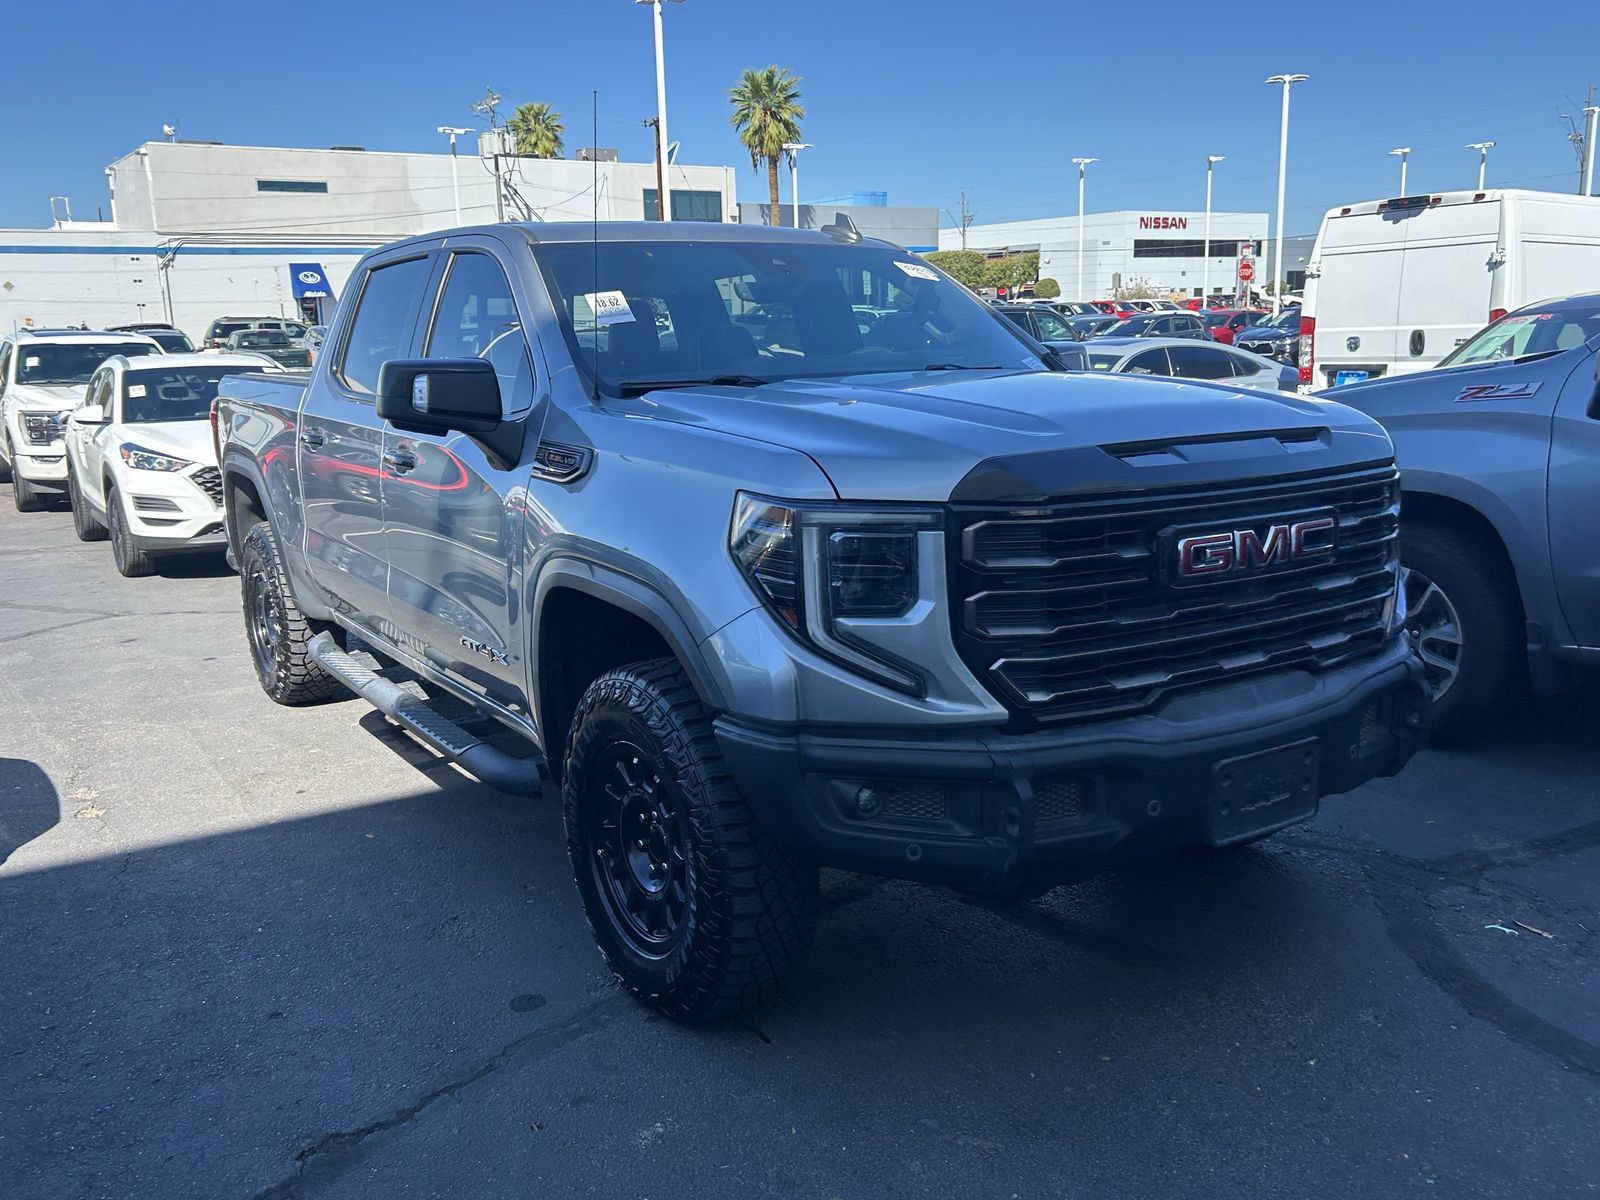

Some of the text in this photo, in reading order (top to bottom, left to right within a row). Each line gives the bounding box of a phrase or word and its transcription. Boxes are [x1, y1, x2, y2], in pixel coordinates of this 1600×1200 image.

[1139, 217, 1187, 229] NISSAN
[1239, 268, 1252, 276] STOP
[1454, 382, 1544, 402] Z71
[1178, 518, 1334, 576] GMC
[459, 635, 510, 666] AT4X
